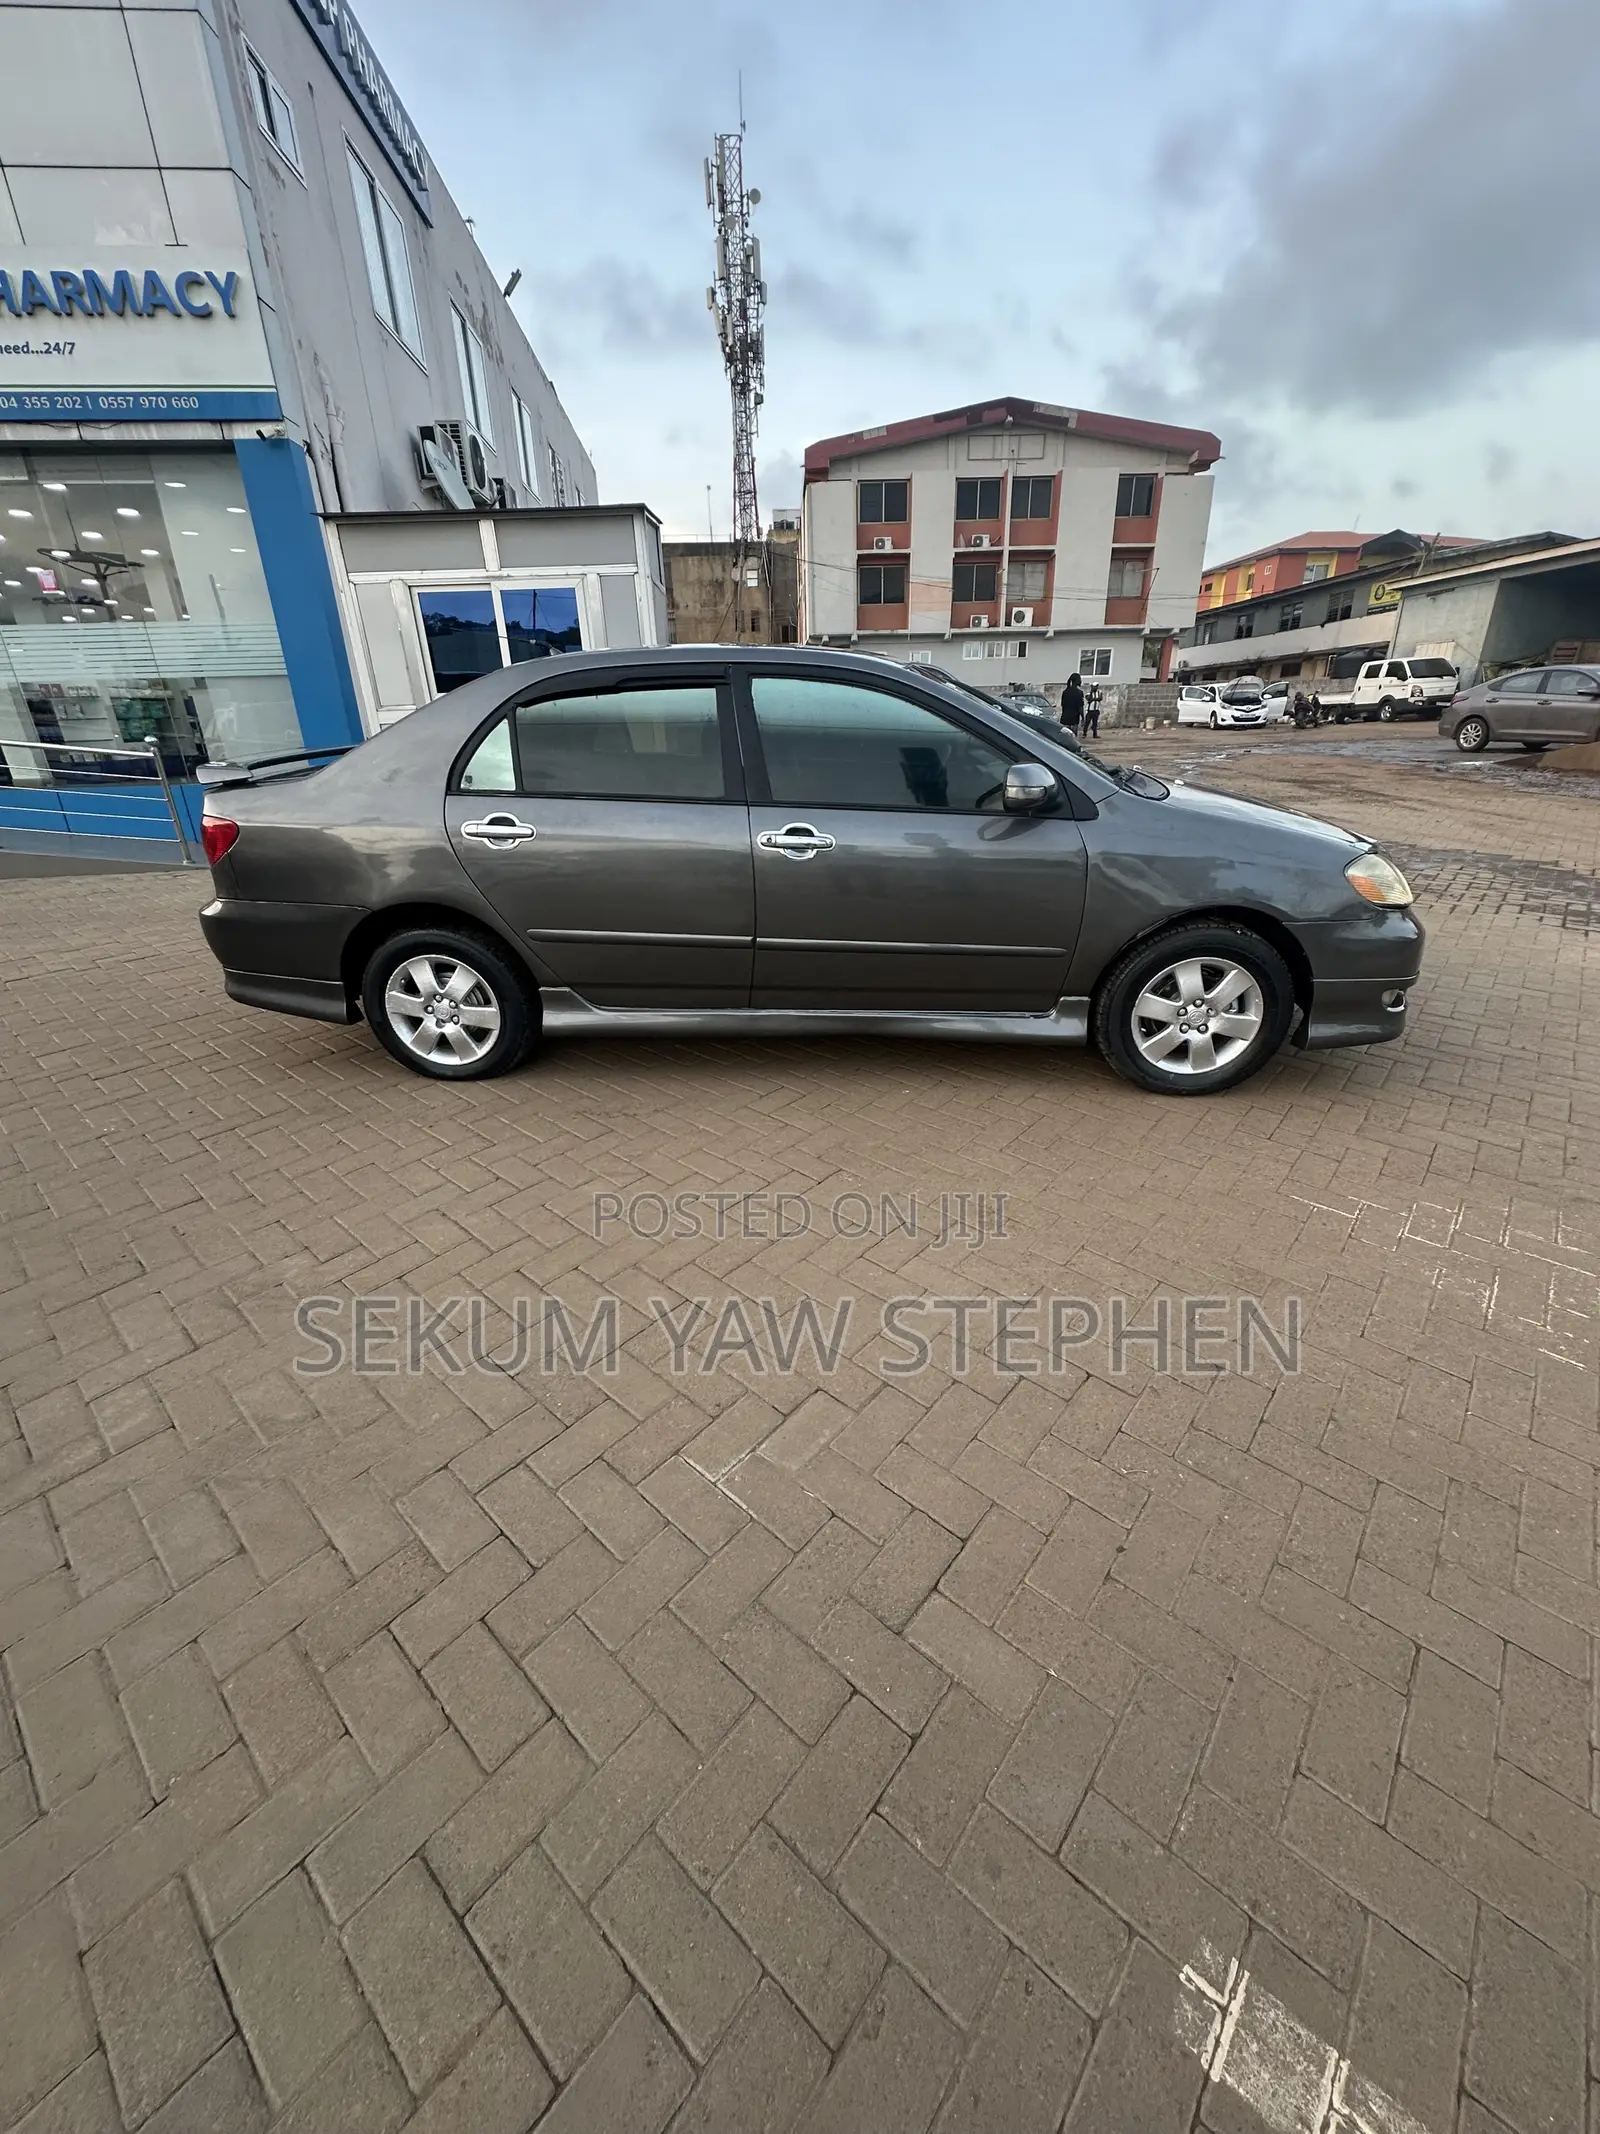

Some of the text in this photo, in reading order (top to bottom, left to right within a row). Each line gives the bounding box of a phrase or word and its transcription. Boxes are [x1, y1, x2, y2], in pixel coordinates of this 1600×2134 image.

[342, 8, 429, 191] PHARMACY
[22, 396, 50, 409] 355
[54, 396, 83, 409] 202
[98, 396, 134, 409] 0557
[139, 396, 167, 409] 970
[171, 396, 199, 409] 660
